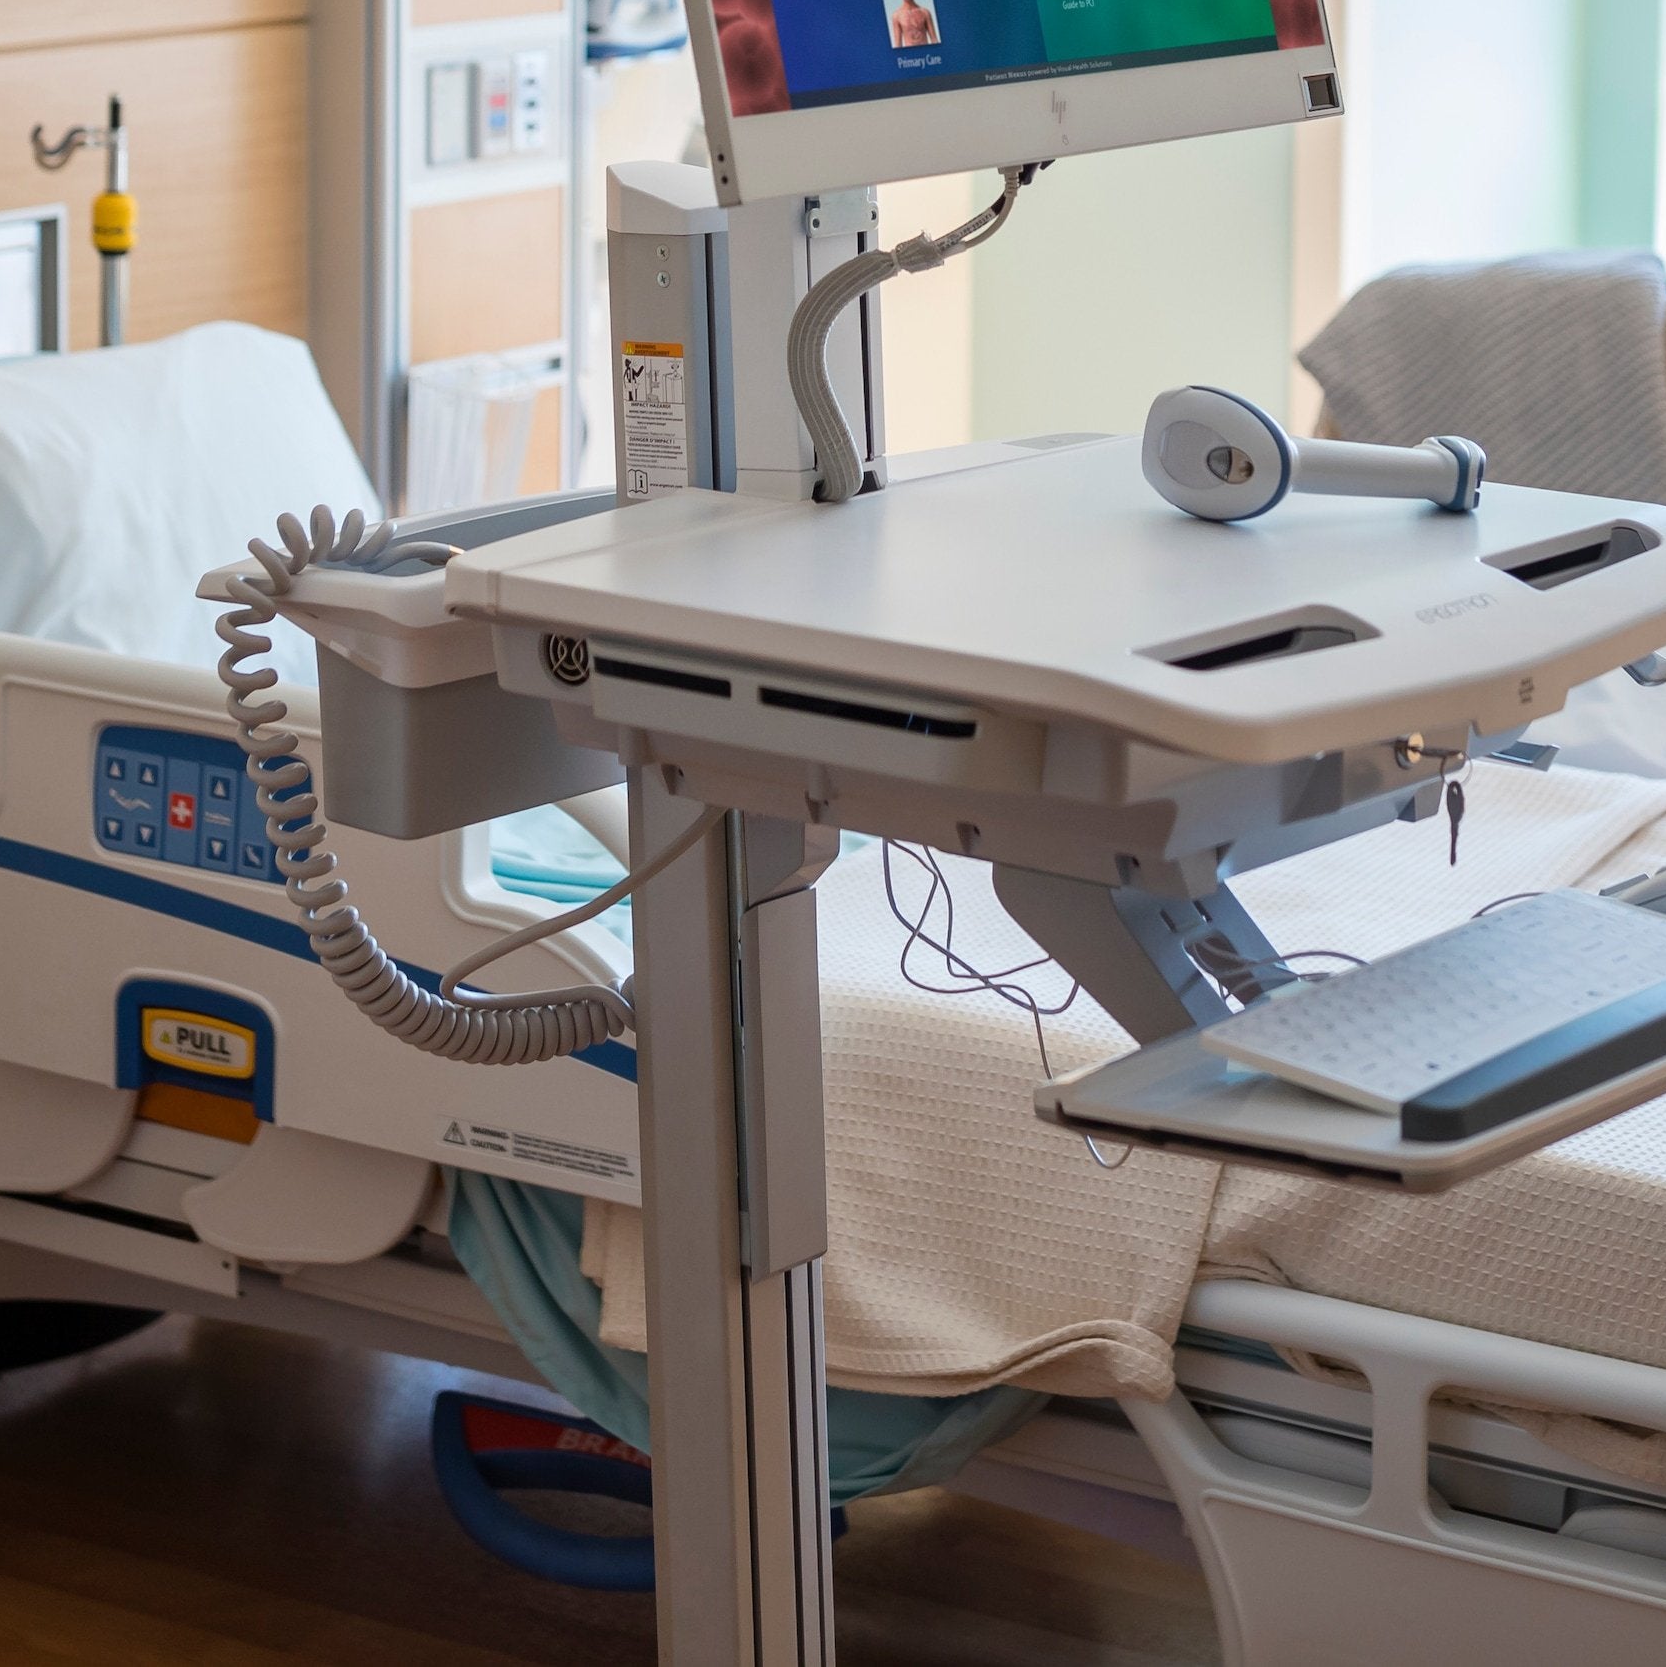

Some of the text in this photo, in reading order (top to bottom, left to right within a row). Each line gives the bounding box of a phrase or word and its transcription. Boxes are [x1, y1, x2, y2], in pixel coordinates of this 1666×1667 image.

[1062, 0, 1079, 10] Guide
[897, 53, 942, 70] Primary Care
[985, 73, 1007, 82] Patient
[1007, 71, 1027, 80] Nexus
[1027, 68, 1051, 78] powered
[176, 1026, 232, 1055] PULL
